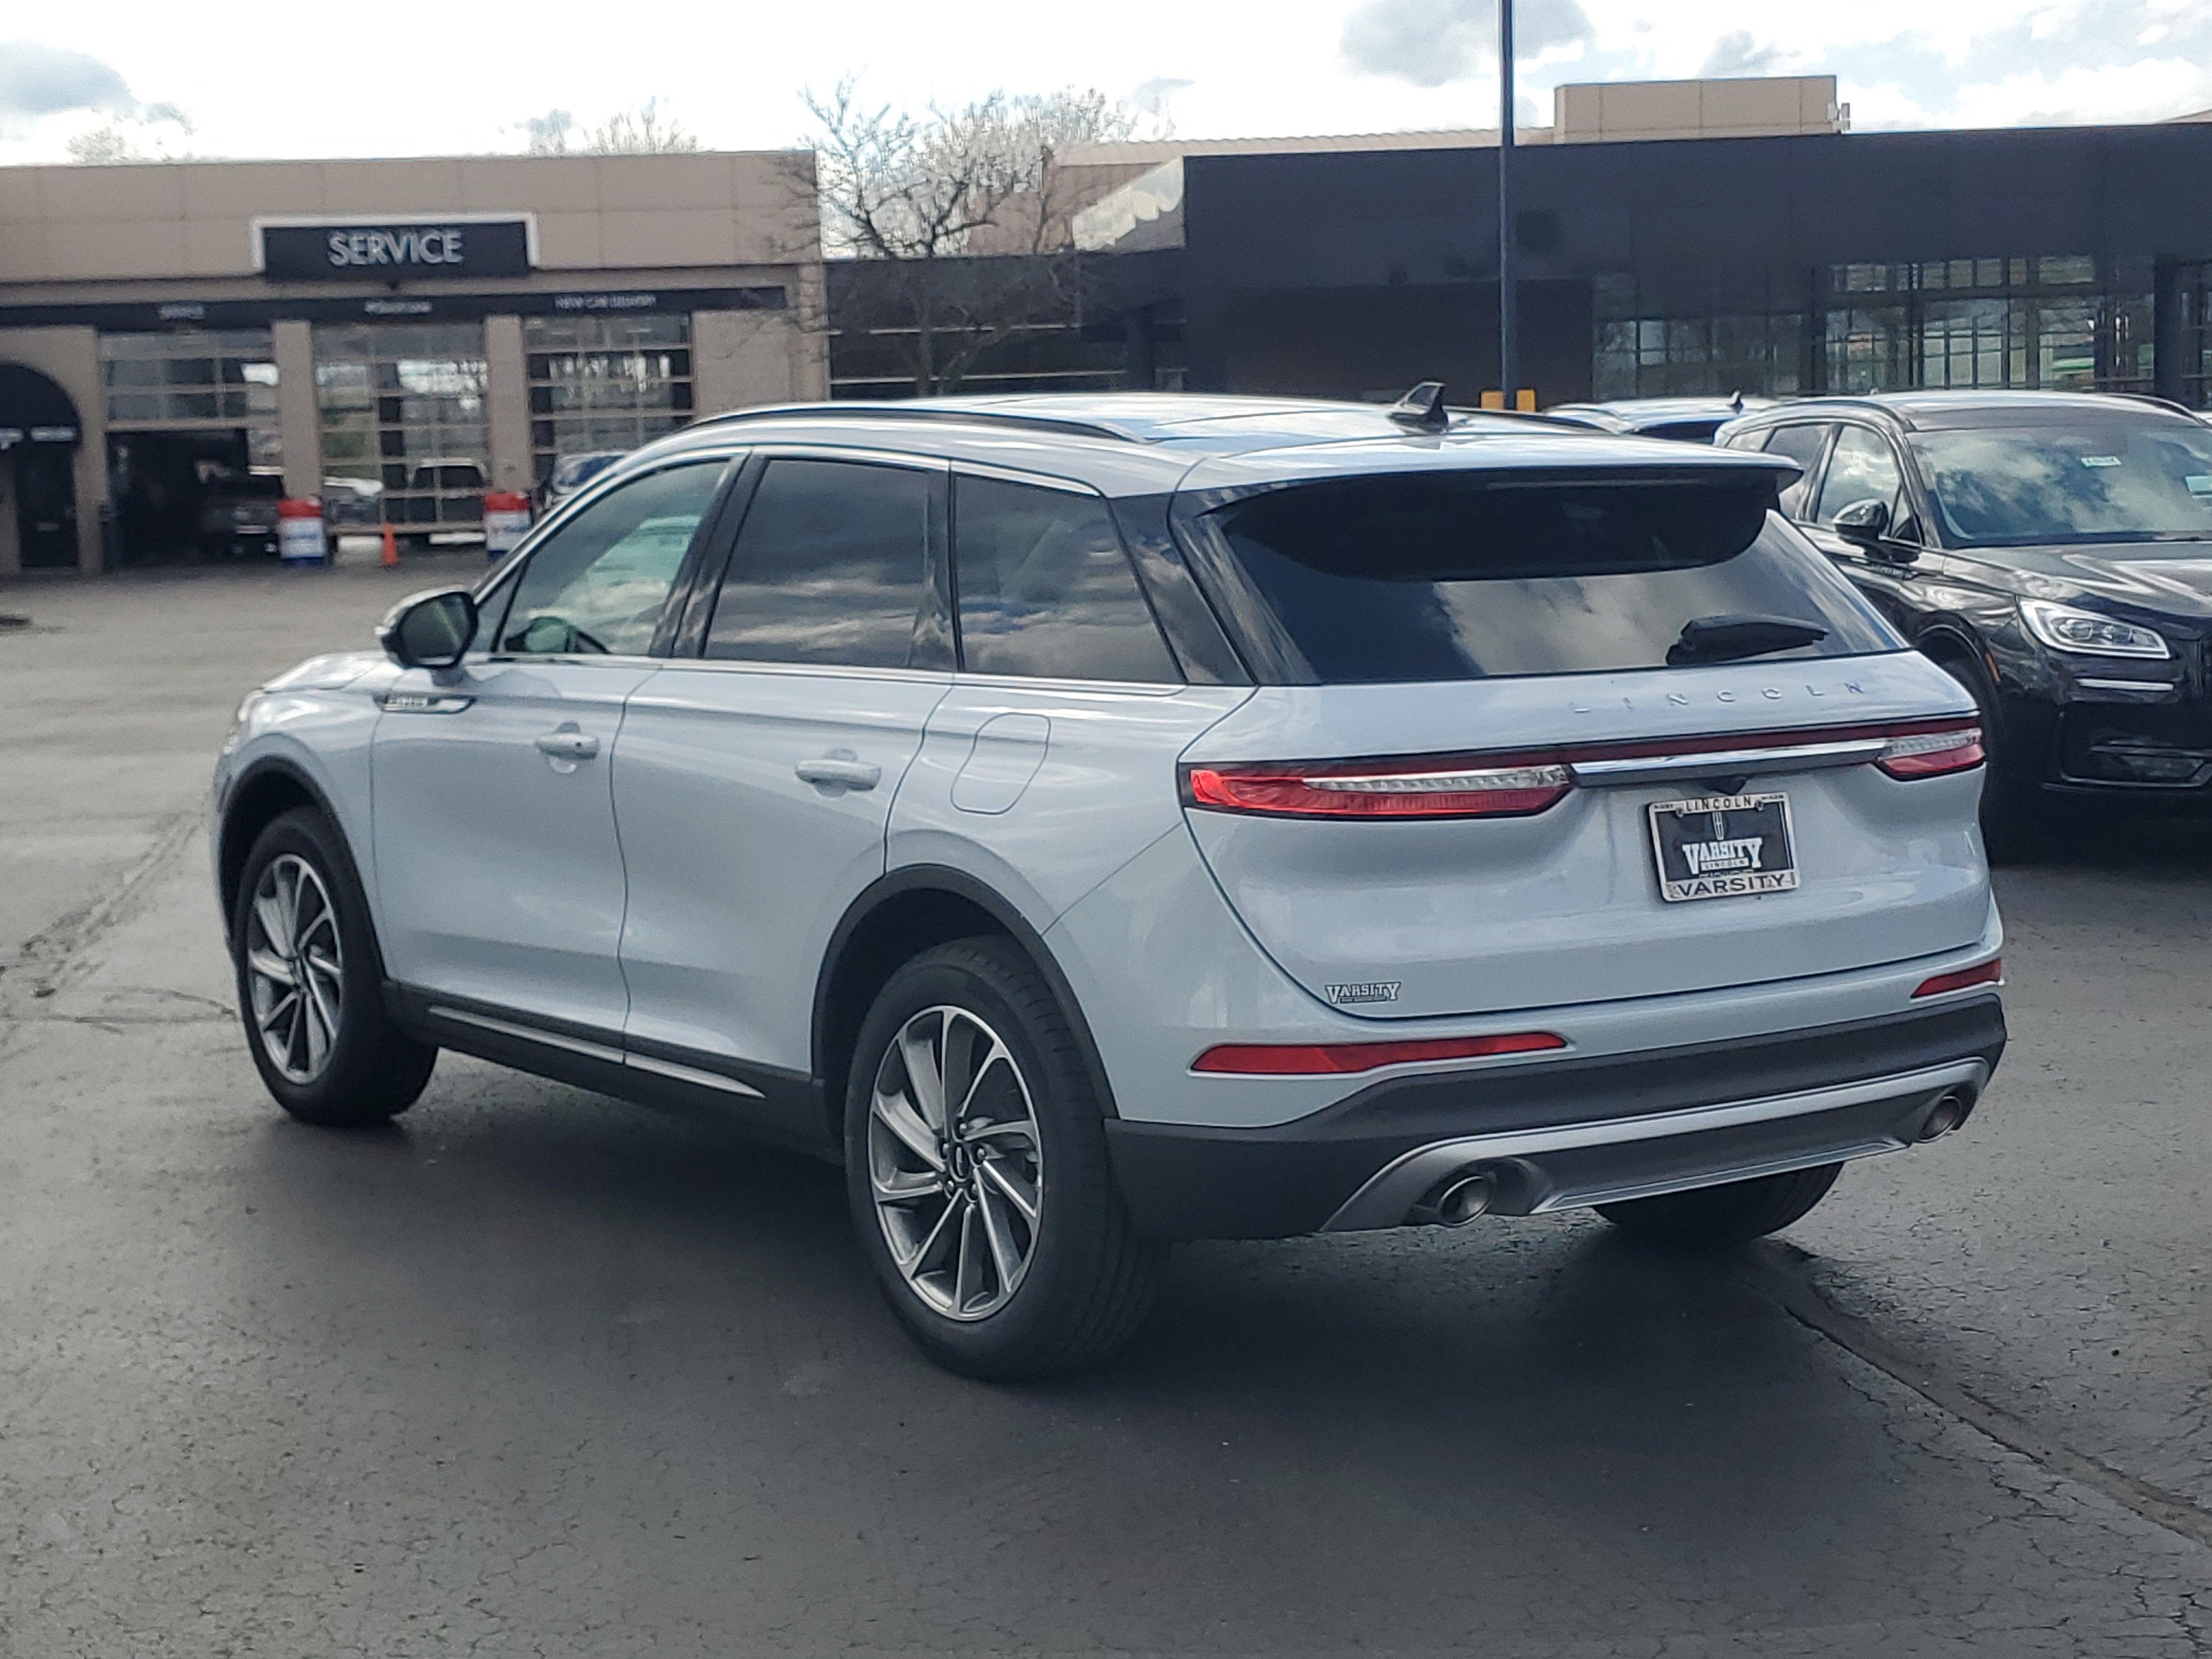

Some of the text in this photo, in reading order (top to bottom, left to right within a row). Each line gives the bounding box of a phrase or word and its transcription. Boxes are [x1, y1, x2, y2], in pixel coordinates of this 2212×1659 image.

[328, 229, 464, 266] SERVICE
[1570, 681, 1865, 713] LINCOLN
[1685, 795, 1752, 812] LINCOLN
[1681, 837, 1763, 874] VARSITY
[1705, 859, 1746, 870] LINCOLN
[1677, 873, 1785, 896] VARSITY
[1324, 981, 1402, 1004] VARSITY
